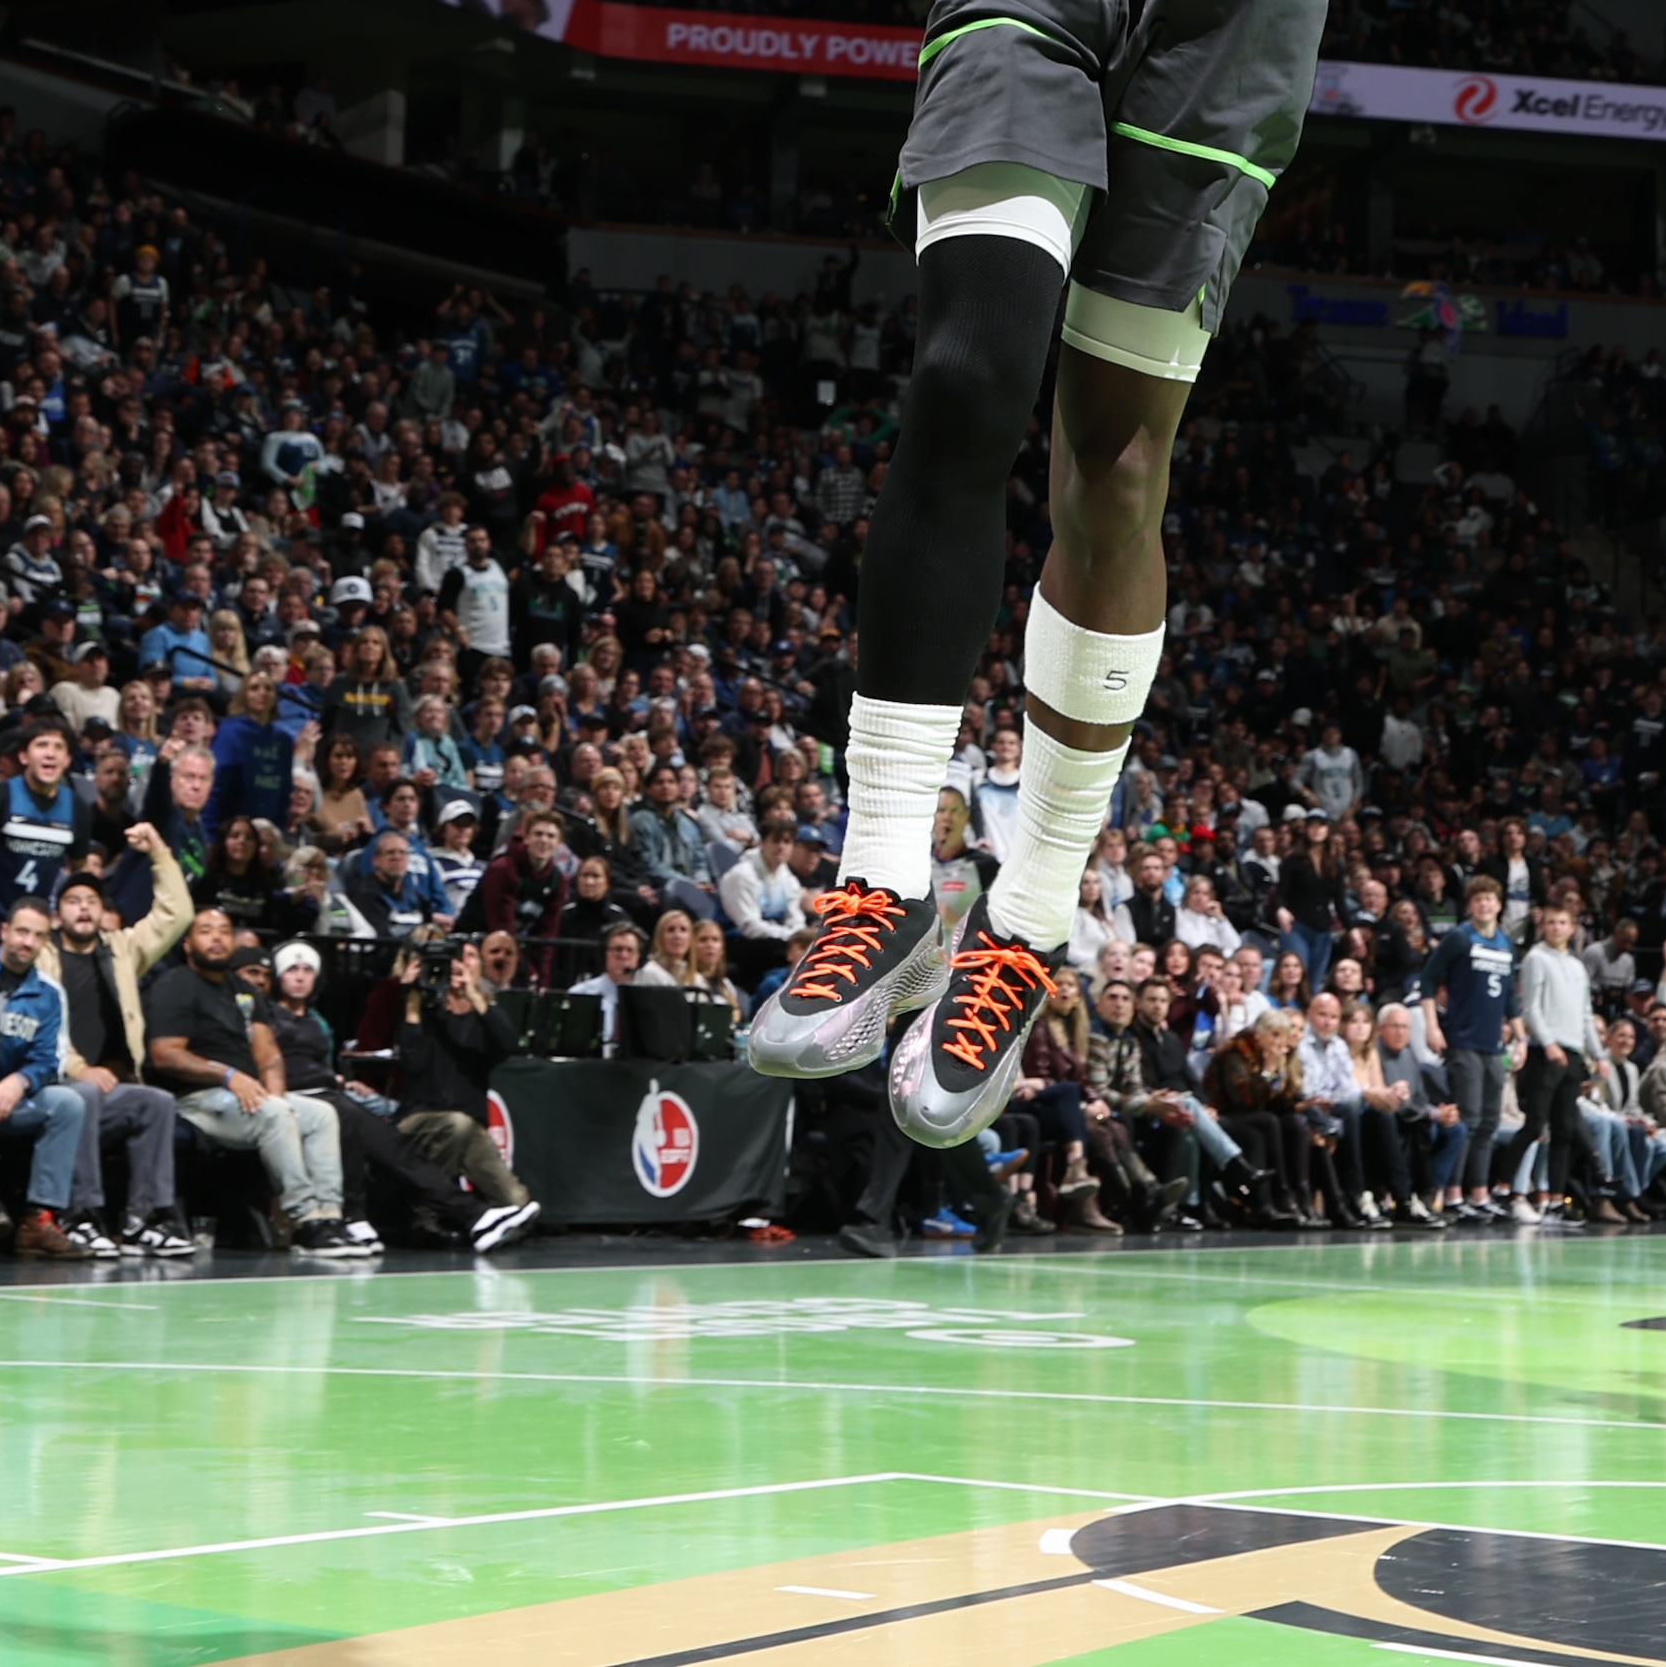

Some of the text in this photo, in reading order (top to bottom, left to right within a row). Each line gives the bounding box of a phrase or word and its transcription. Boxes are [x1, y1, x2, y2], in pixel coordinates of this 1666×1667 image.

[667, 21, 920, 68] PROUDLY POWE
[1510, 86, 1583, 122] Xcel
[1102, 668, 1131, 692] 5
[15, 857, 39, 893] 4
